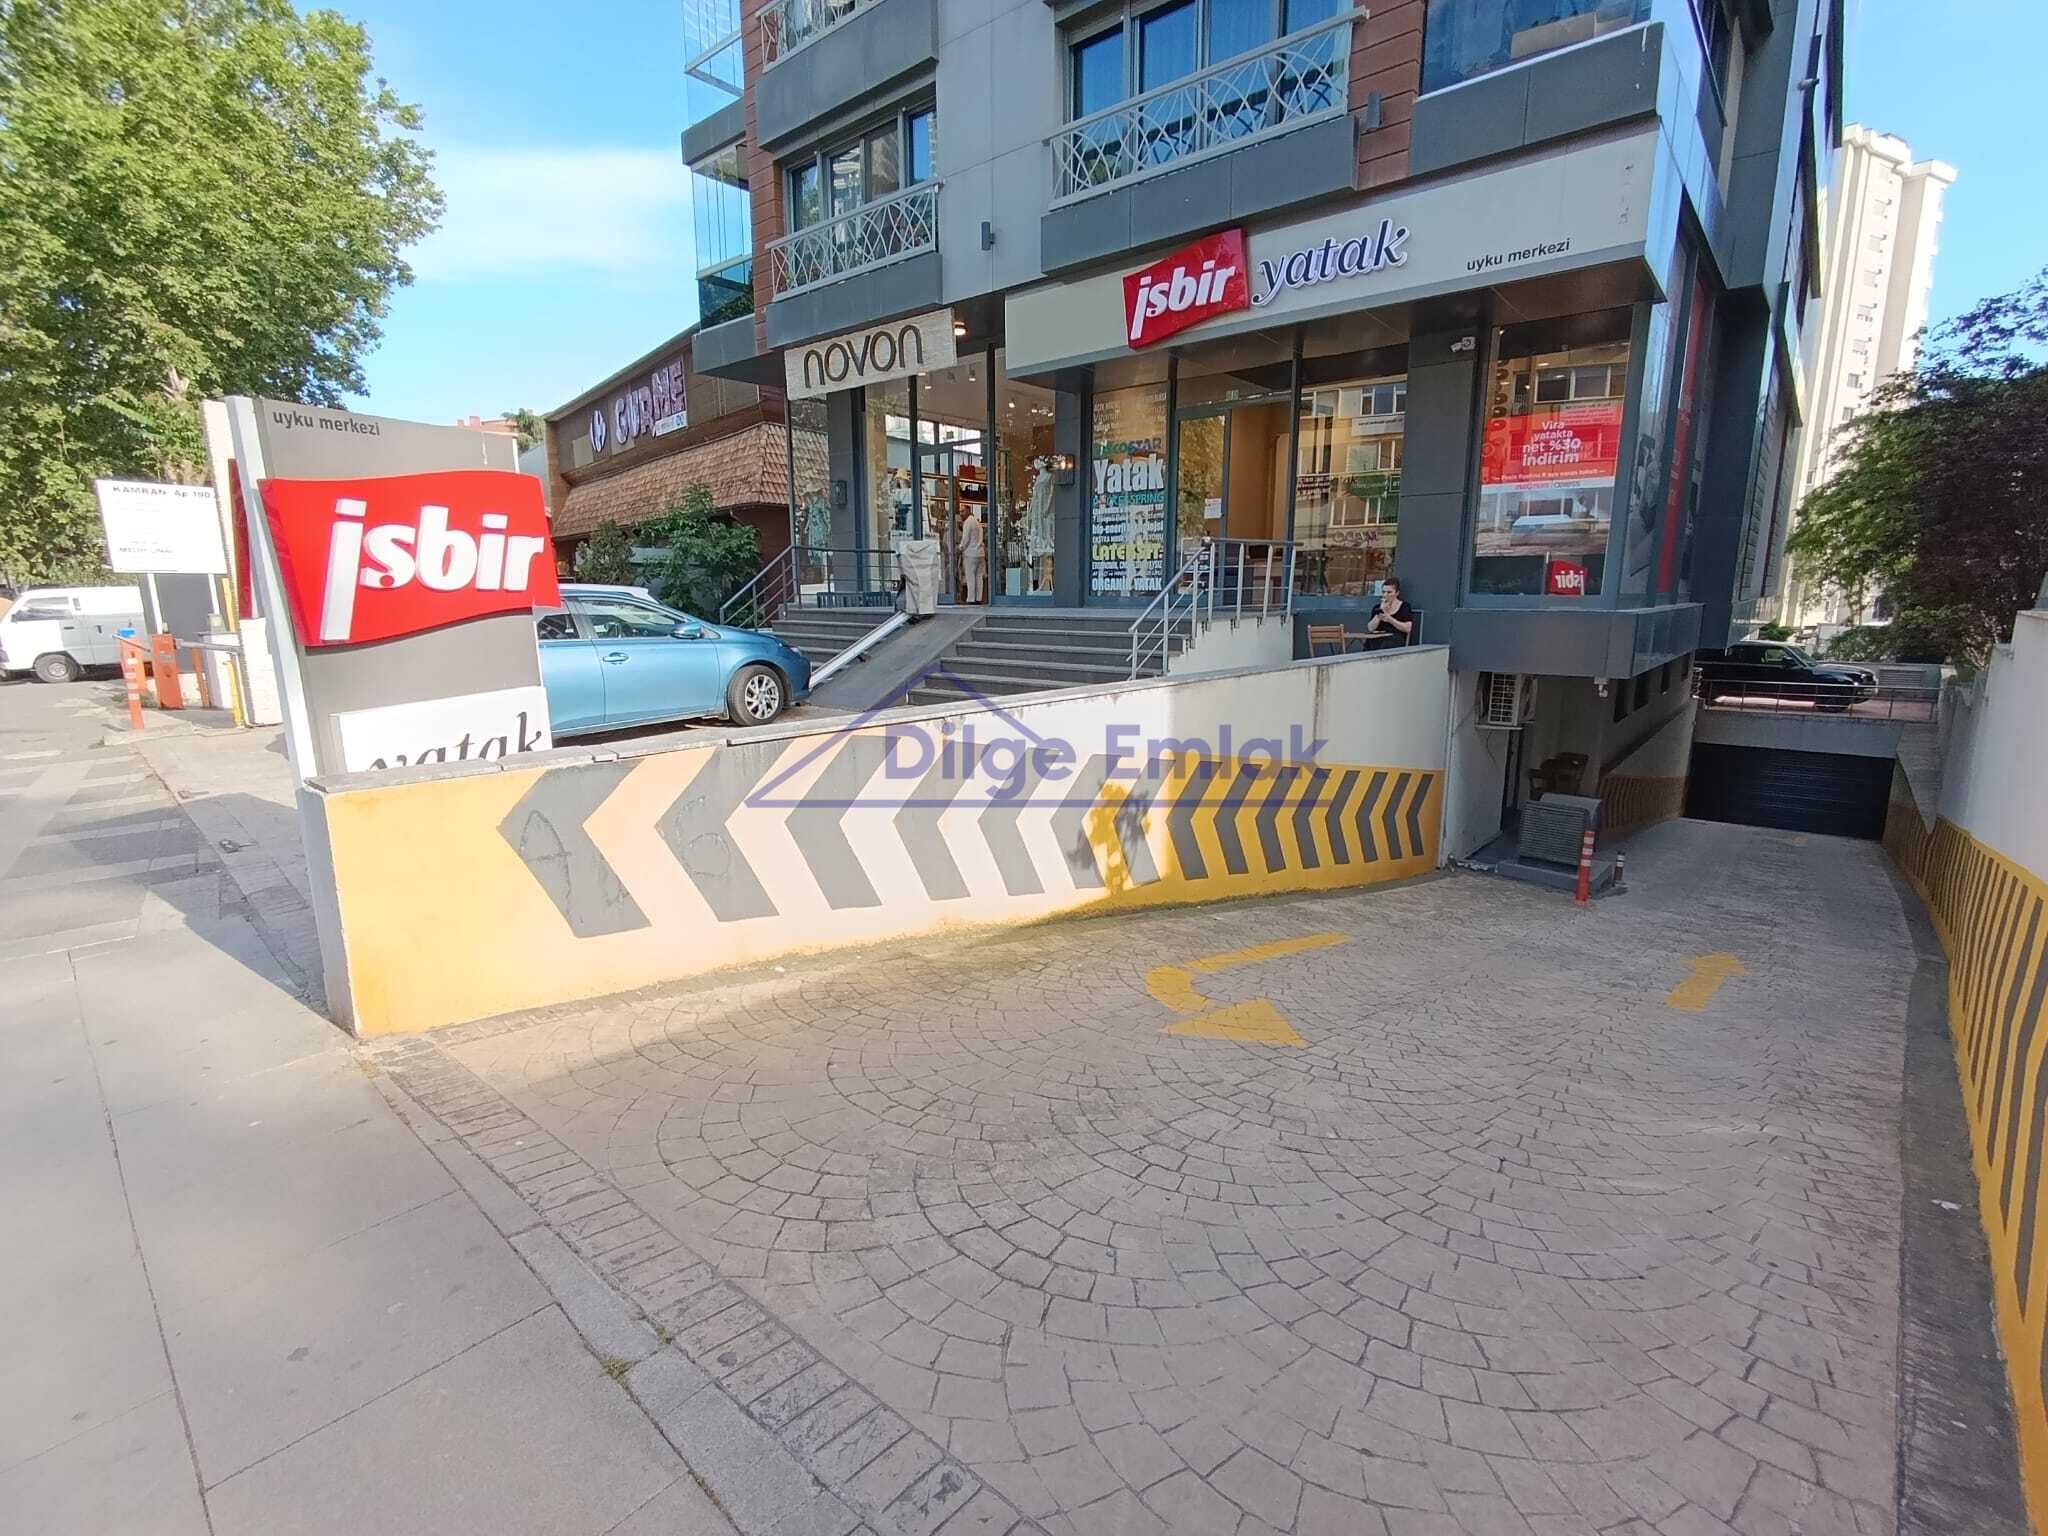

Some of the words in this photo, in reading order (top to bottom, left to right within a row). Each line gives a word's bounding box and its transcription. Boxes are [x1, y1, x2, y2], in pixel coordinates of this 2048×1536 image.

[1252, 218, 1408, 306] yatak
[1467, 254, 1502, 272] uyku
[1508, 238, 1570, 262] merkezi
[803, 324, 923, 389] novon
[273, 410, 313, 429] uyku
[320, 418, 381, 436] merkezi
[1522, 443, 1545, 454] net
[1093, 453, 1164, 494] Yatak
